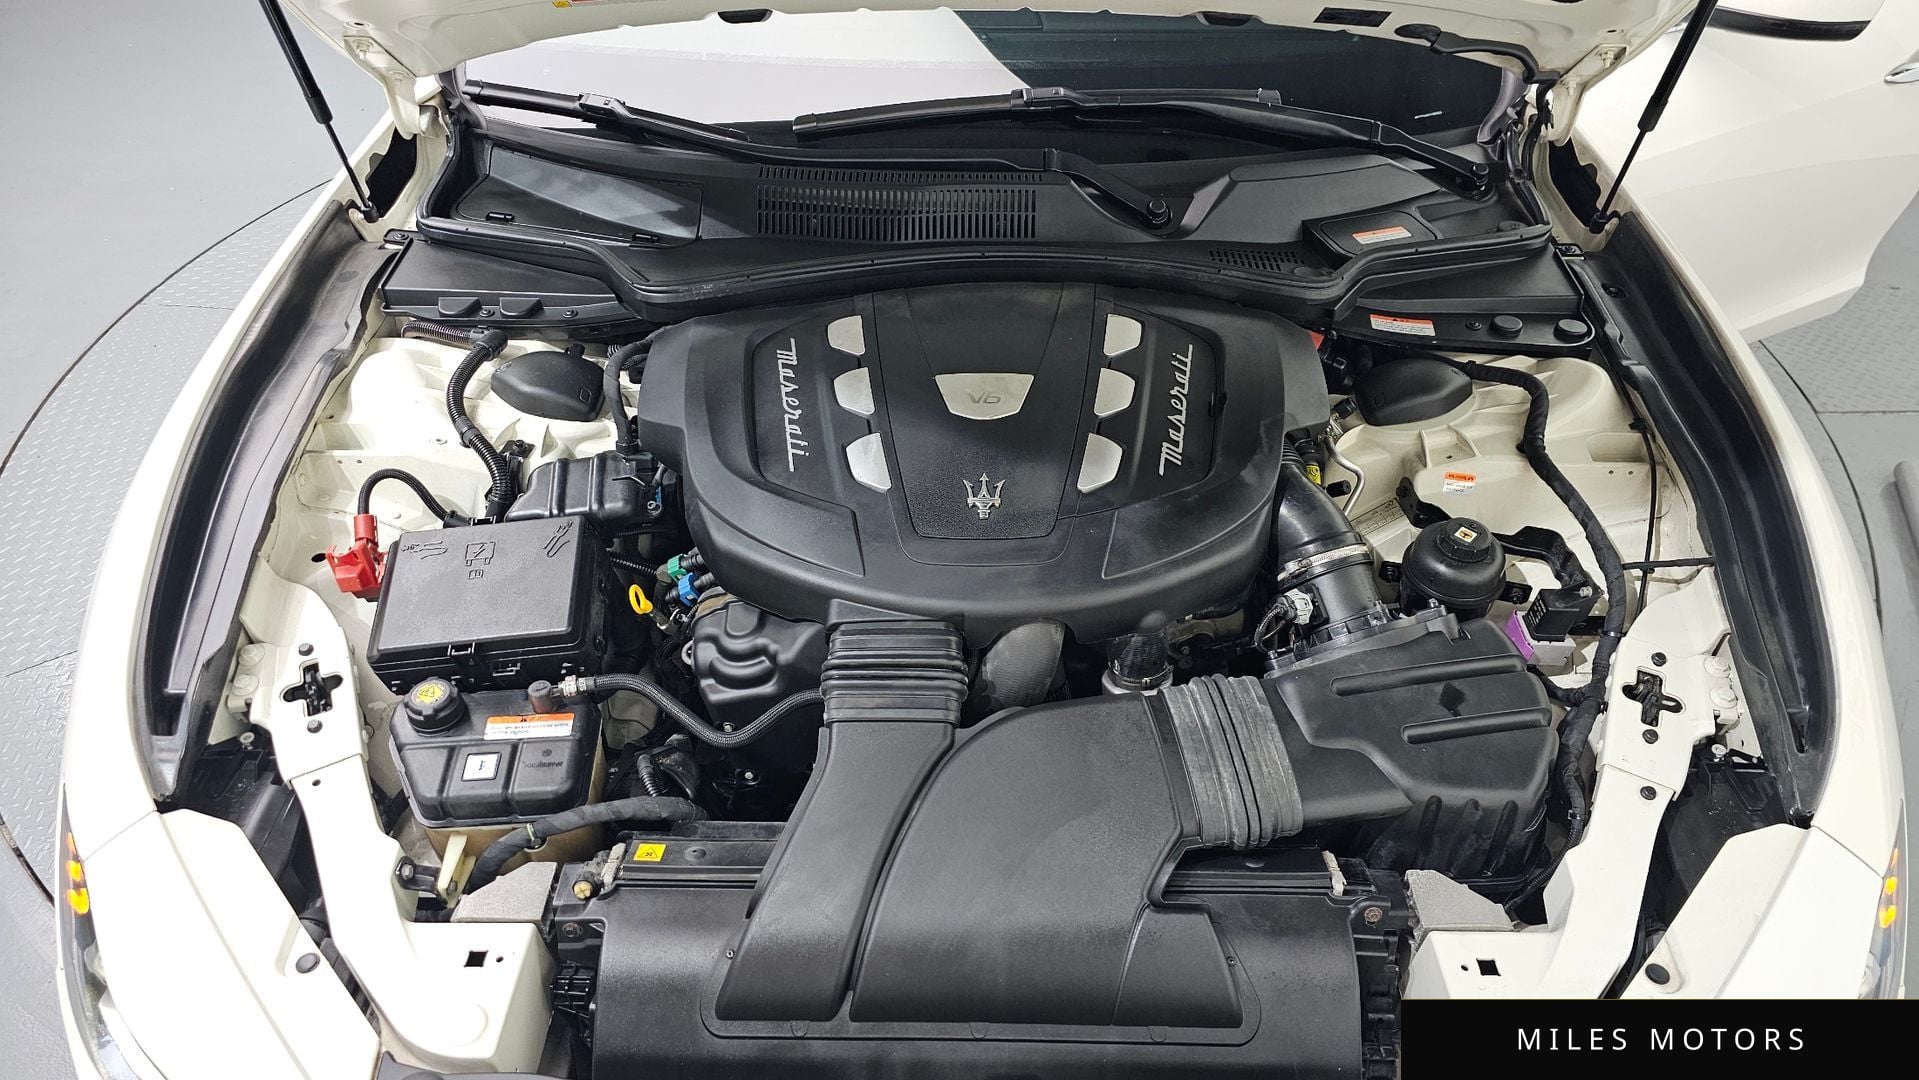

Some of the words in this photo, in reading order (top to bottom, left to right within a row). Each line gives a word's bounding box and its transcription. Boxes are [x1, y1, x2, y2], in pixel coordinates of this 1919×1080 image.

[776, 338, 809, 472] Maserati
[968, 391, 1001, 404] V6
[1159, 344, 1194, 476] Maserati
